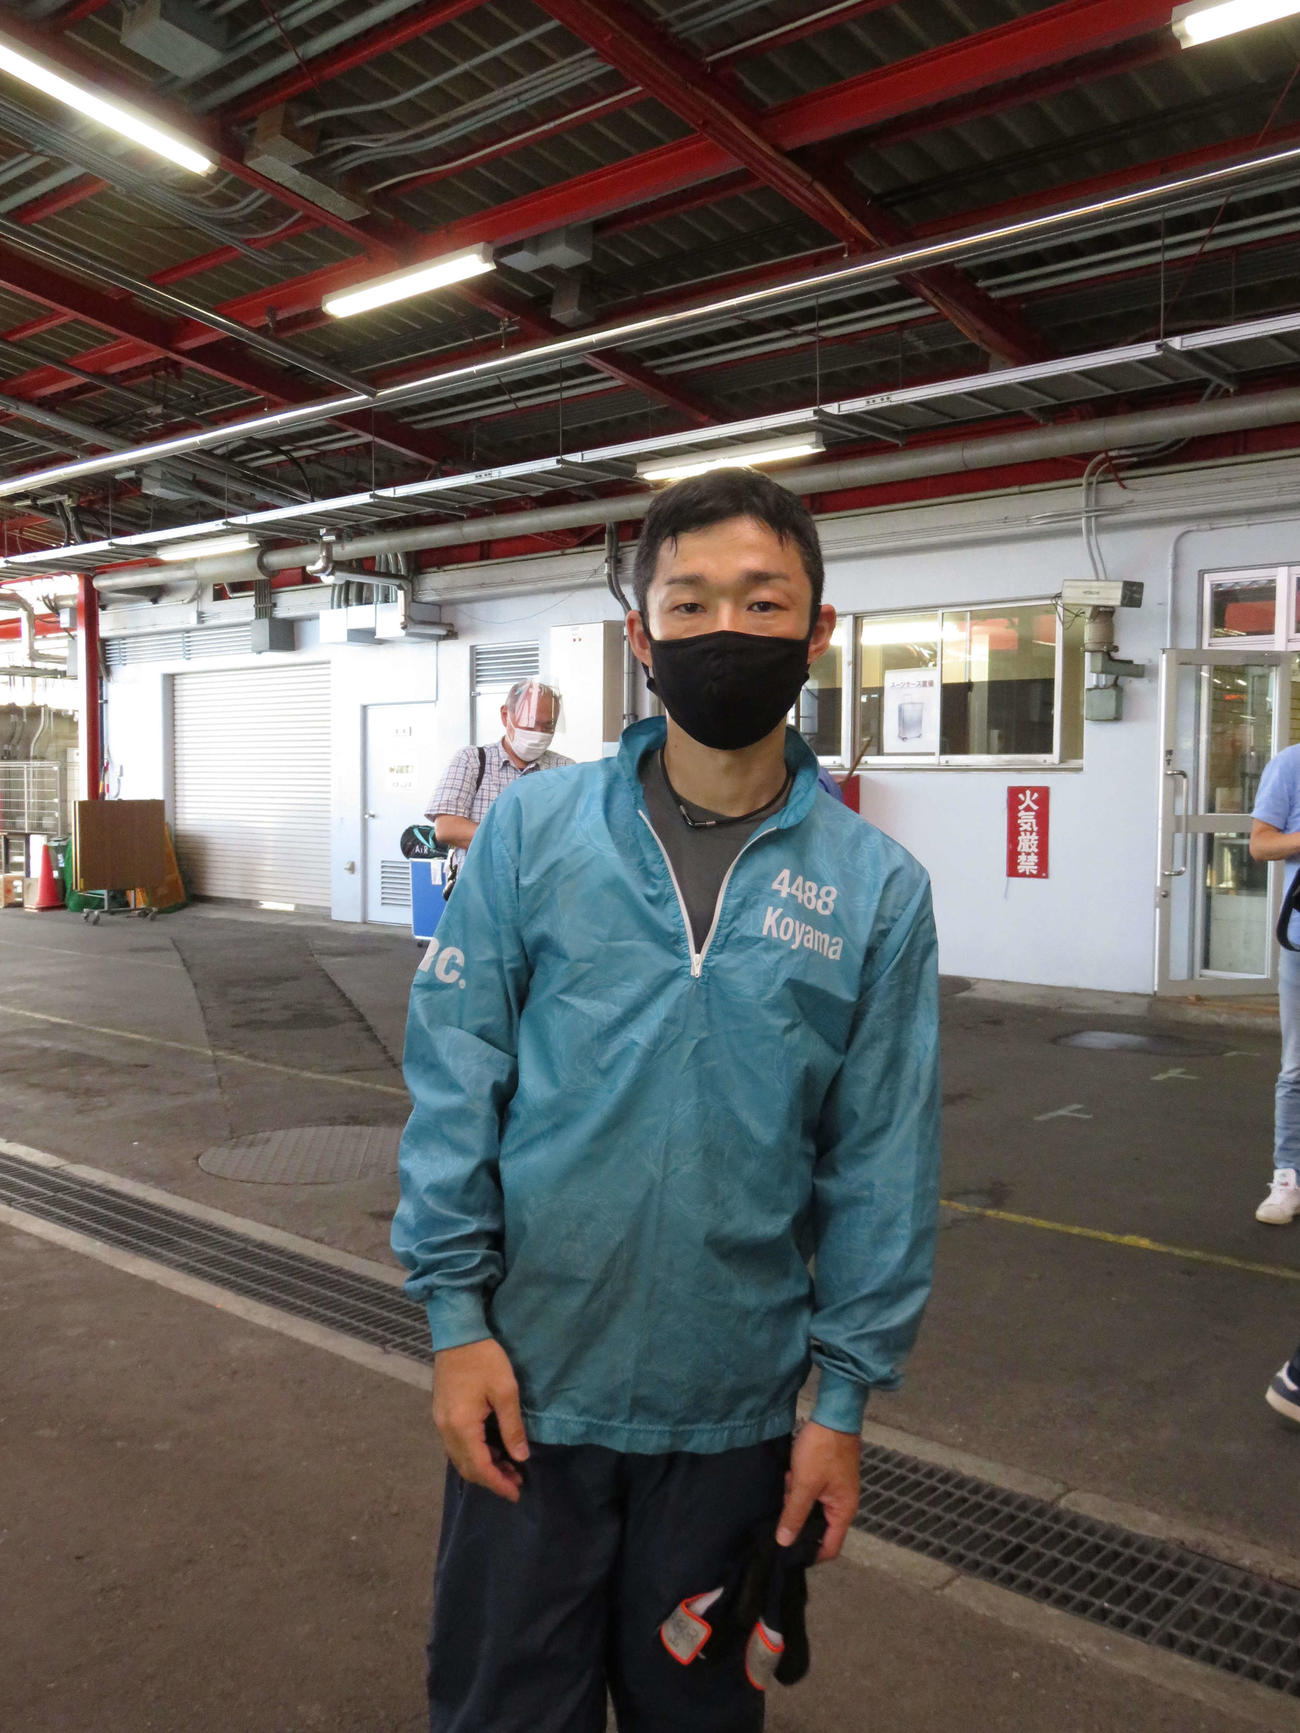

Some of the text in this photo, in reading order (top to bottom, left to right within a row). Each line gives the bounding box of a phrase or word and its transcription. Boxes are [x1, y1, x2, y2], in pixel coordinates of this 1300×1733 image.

[1016, 789, 1040, 876] 火気厳禁
[771, 868, 838, 916] 4488
[762, 906, 844, 961] Koyama
